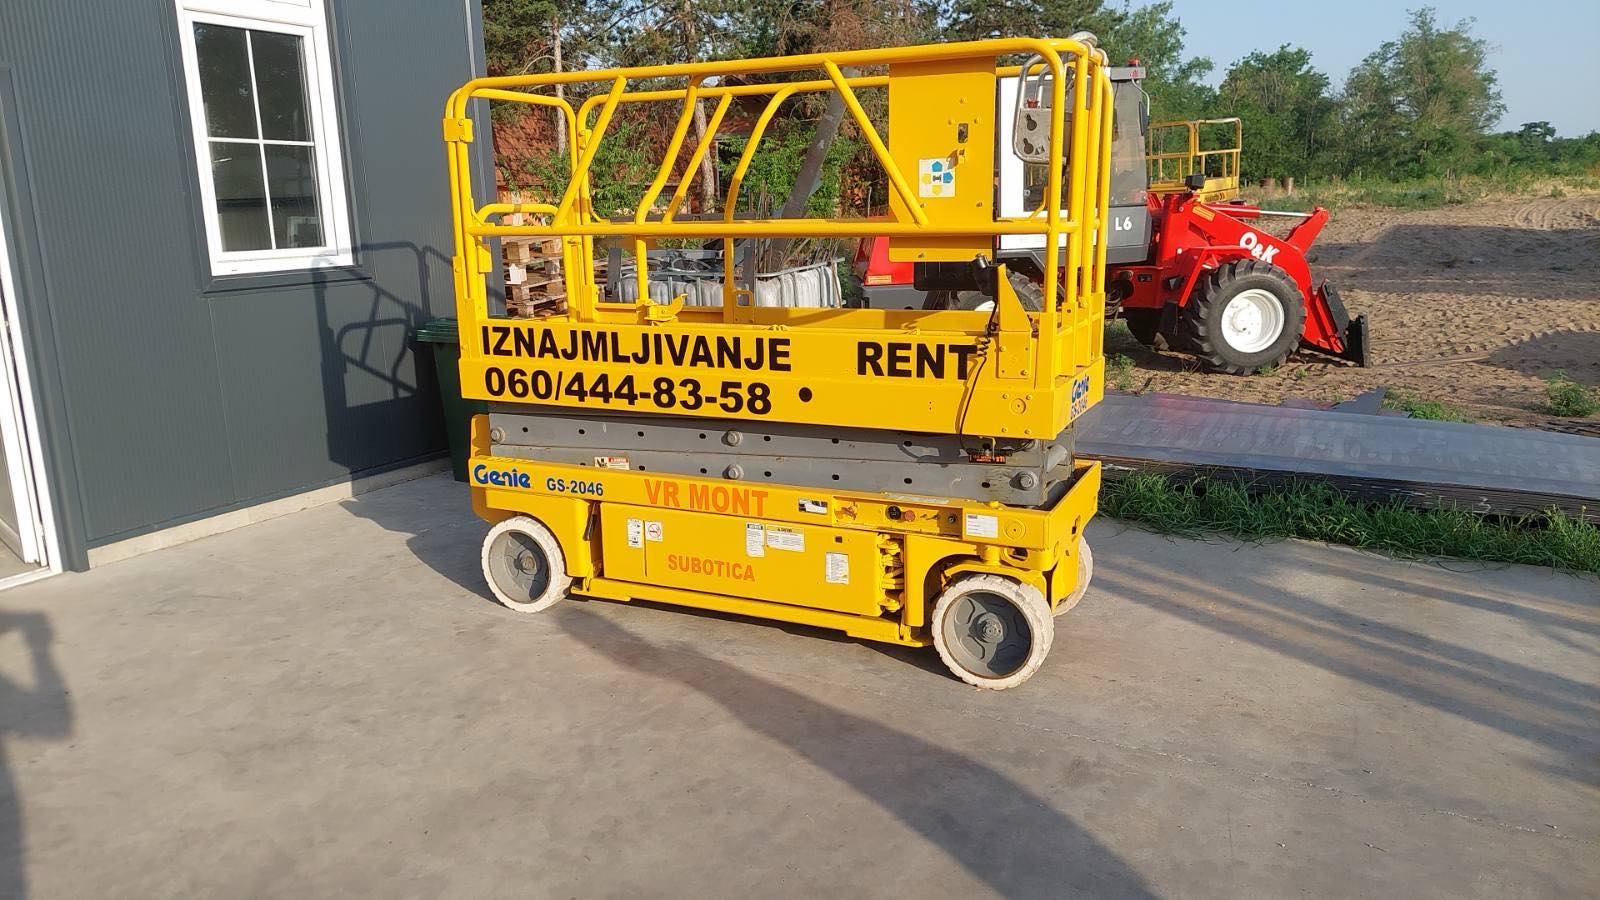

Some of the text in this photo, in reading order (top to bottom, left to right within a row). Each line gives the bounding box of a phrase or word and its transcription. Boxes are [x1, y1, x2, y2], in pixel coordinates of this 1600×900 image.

[1115, 216, 1132, 231] L6
[1239, 231, 1280, 264] O&K
[481, 325, 978, 381] IZNAJMLJIVANJE RENT
[484, 366, 772, 415] 060/444-83-58
[473, 464, 604, 497] Genie GS-2046
[643, 479, 769, 518] VR MONT
[667, 554, 756, 582] SUBOTICA
